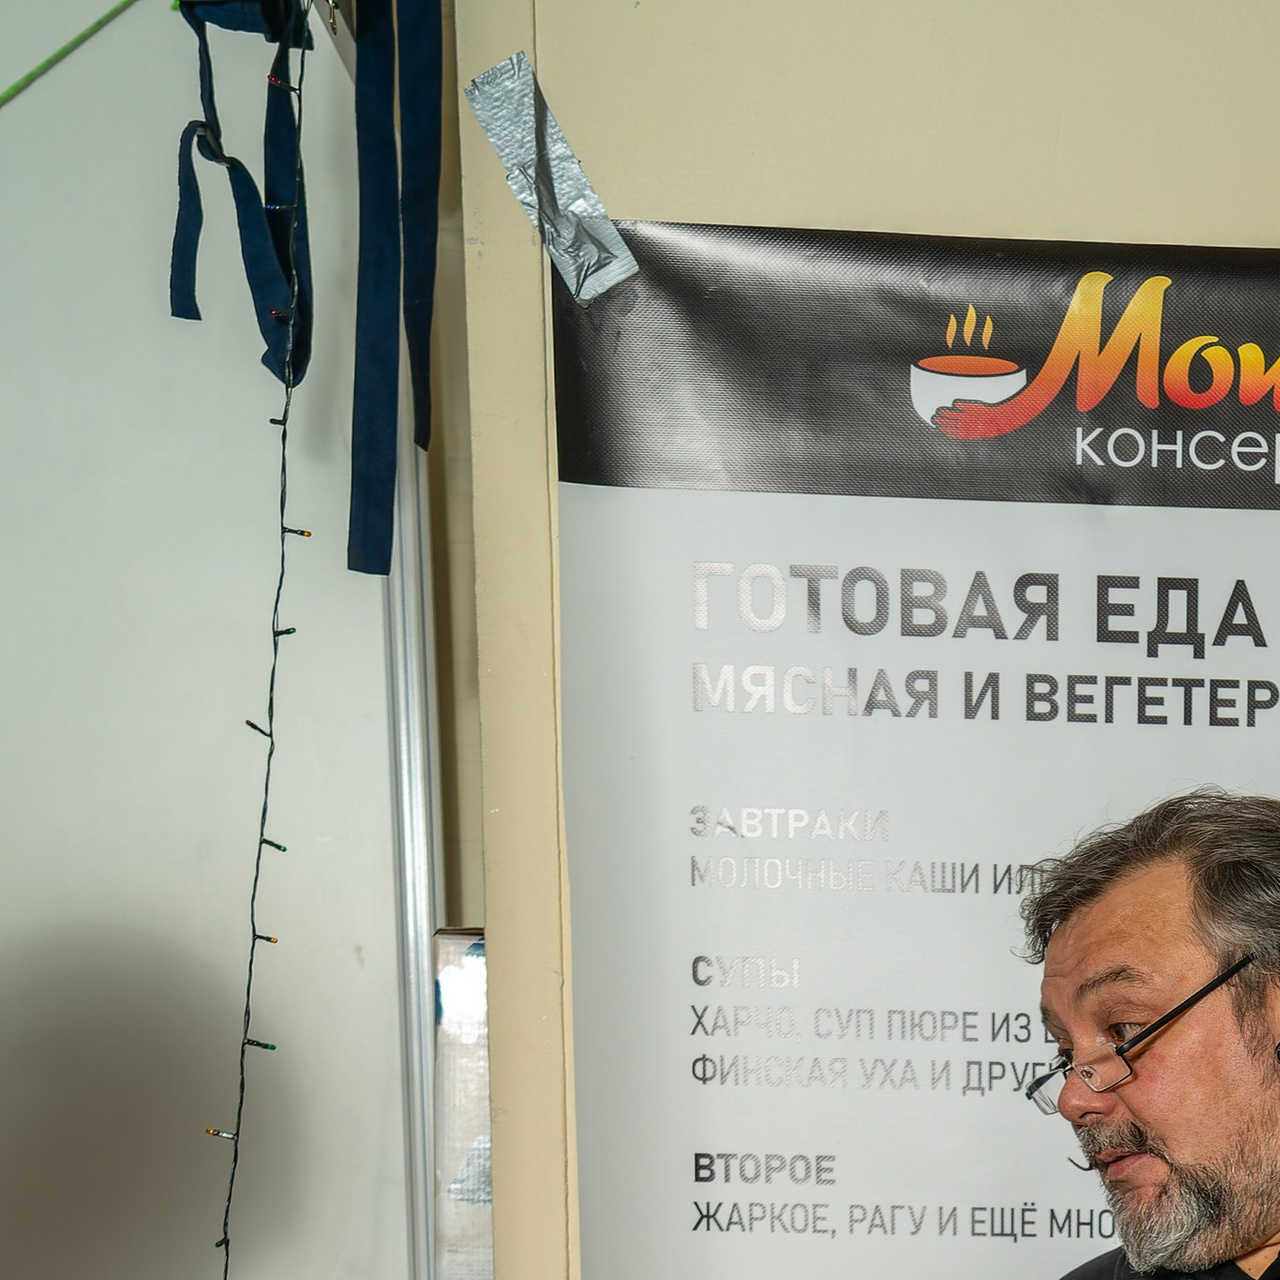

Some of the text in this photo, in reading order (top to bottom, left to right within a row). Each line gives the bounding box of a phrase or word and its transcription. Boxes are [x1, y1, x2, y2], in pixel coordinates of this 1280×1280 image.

[692, 560, 1060, 642] ГОТОВАЯ
[1096, 574, 1269, 660] ЕДА
[691, 662, 939, 719] МЯСНАЯ
[963, 670, 1001, 721] И
[689, 804, 890, 842] ЗАВТРАКИ
[689, 855, 876, 893] МОЛОЧНЫЕ
[885, 860, 980, 894] КАШИ
[691, 954, 801, 989] СУПЫ
[690, 1004, 803, 1044] ХАРЧО,
[812, 1006, 875, 1040] СУП
[887, 1008, 979, 1043] ПЮРЕ
[991, 1011, 1032, 1043] ИЗ
[691, 1052, 848, 1088] ФИНСКАЯ
[858, 1056, 921, 1091] УХА
[930, 1058, 952, 1092] И
[692, 1152, 837, 1186] ВТОРОЕ
[691, 1200, 838, 1240] ЖАРКОЕ,
[848, 1203, 928, 1237] РАГУ
[937, 1205, 959, 1237] И
[970, 1202, 1038, 1243] ЕЩЁ
